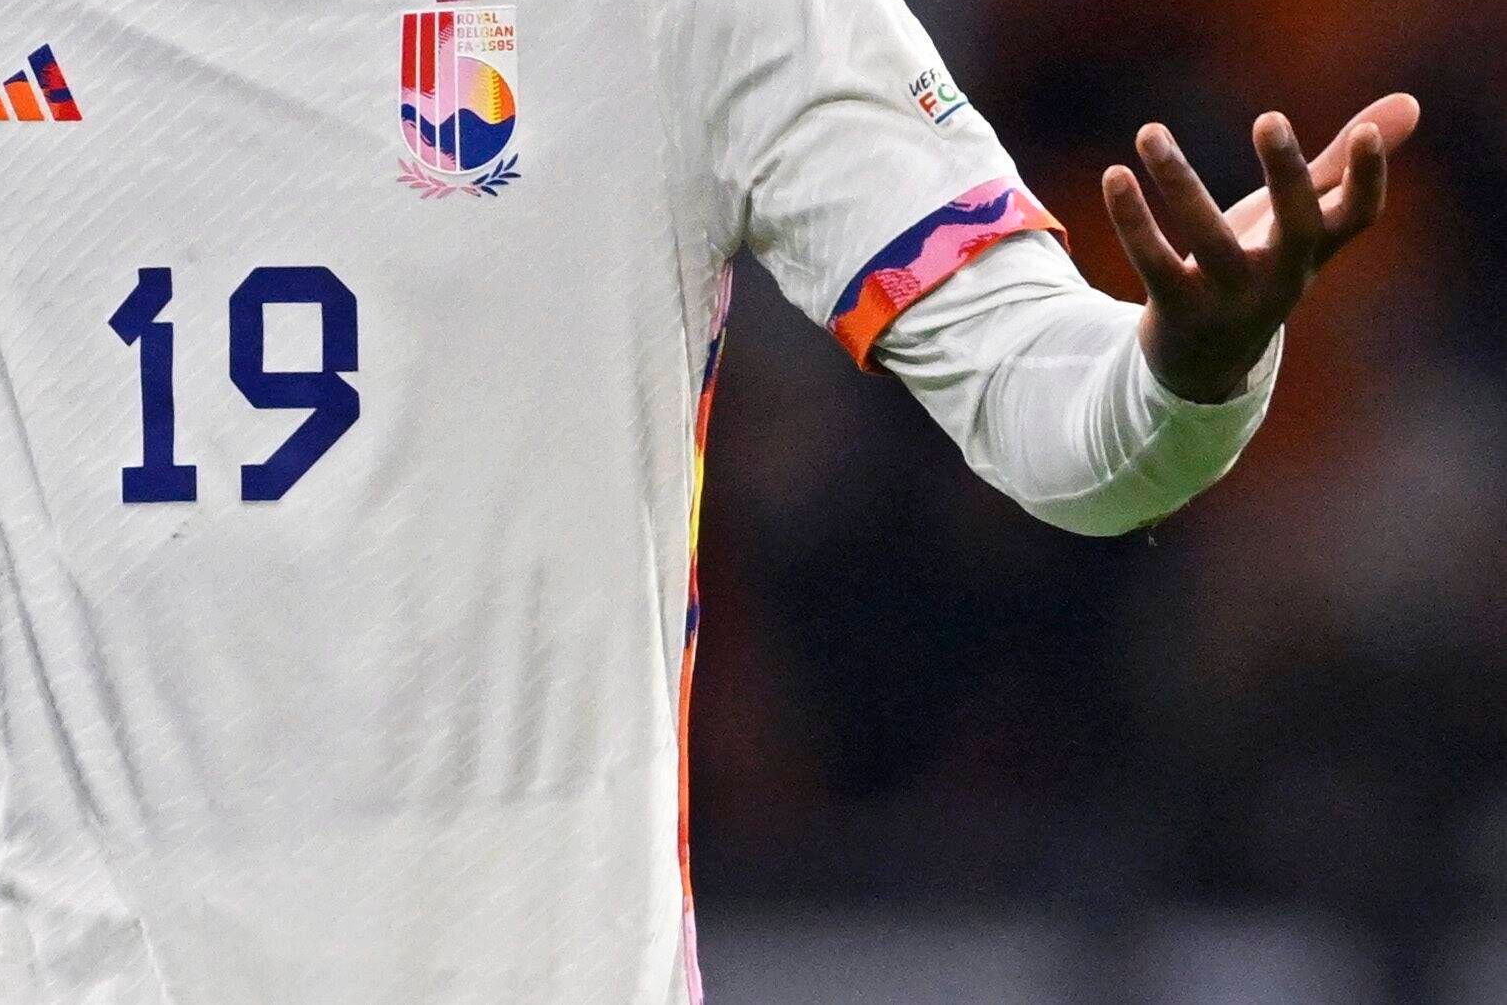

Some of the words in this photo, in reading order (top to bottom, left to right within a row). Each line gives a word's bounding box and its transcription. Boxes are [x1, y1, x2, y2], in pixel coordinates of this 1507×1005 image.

[457, 12, 498, 25] ROYAL
[457, 25, 514, 38] BELGIAN
[108, 266, 360, 503] 19
